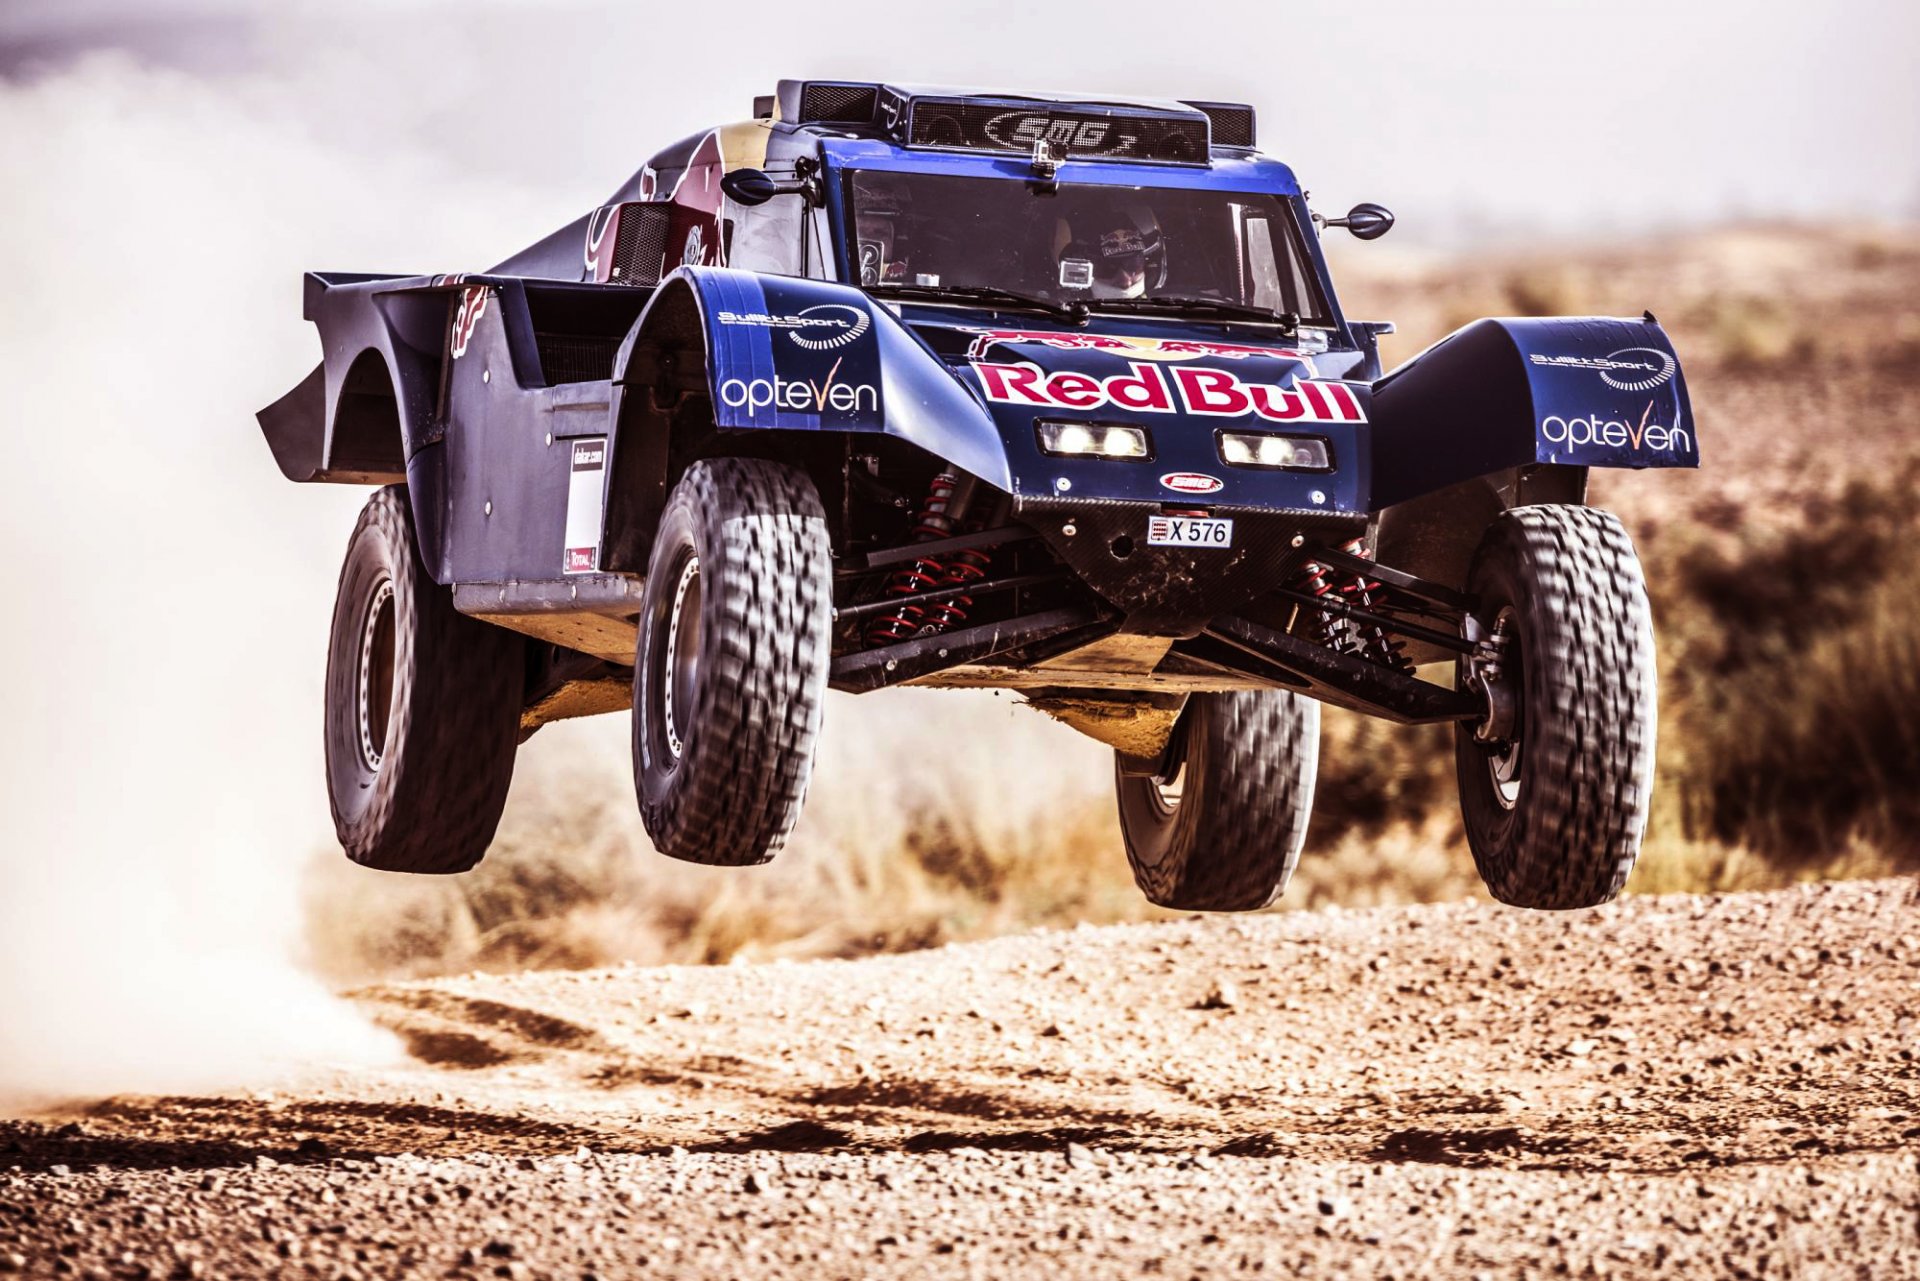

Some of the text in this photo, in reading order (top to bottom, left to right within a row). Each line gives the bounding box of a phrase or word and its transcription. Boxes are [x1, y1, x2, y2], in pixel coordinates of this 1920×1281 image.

[1012, 117, 1110, 147] SMG
[721, 356, 878, 418] opteven
[971, 362, 1367, 424] Red Bull
[1542, 400, 1691, 454] opteven
[574, 447, 603, 465] dakar.com
[1170, 521, 1226, 543] X 576
